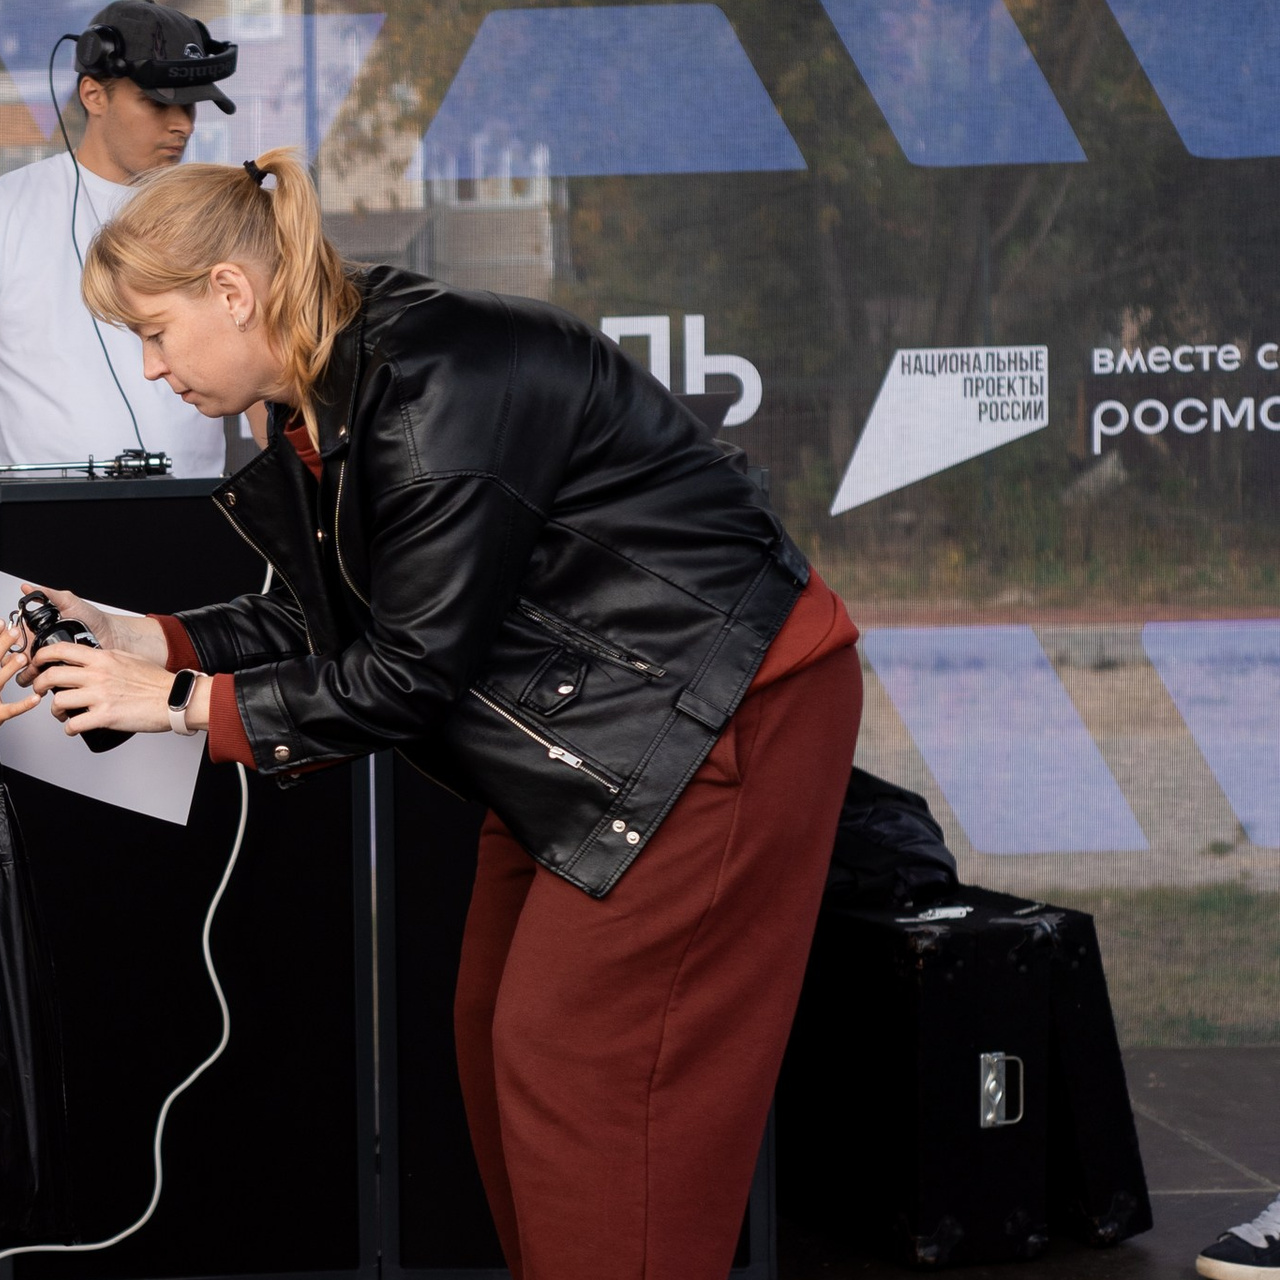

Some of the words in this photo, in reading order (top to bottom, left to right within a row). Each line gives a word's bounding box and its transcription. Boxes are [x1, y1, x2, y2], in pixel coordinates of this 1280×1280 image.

[901, 350, 1045, 377] НАЦИОНАЛЬНЫЕ
[1093, 344, 1241, 374] вместе
[1257, 342, 1279, 371] с
[963, 376, 1044, 398] ПРОЕКТЫ
[978, 400, 1044, 422] РОССИИ
